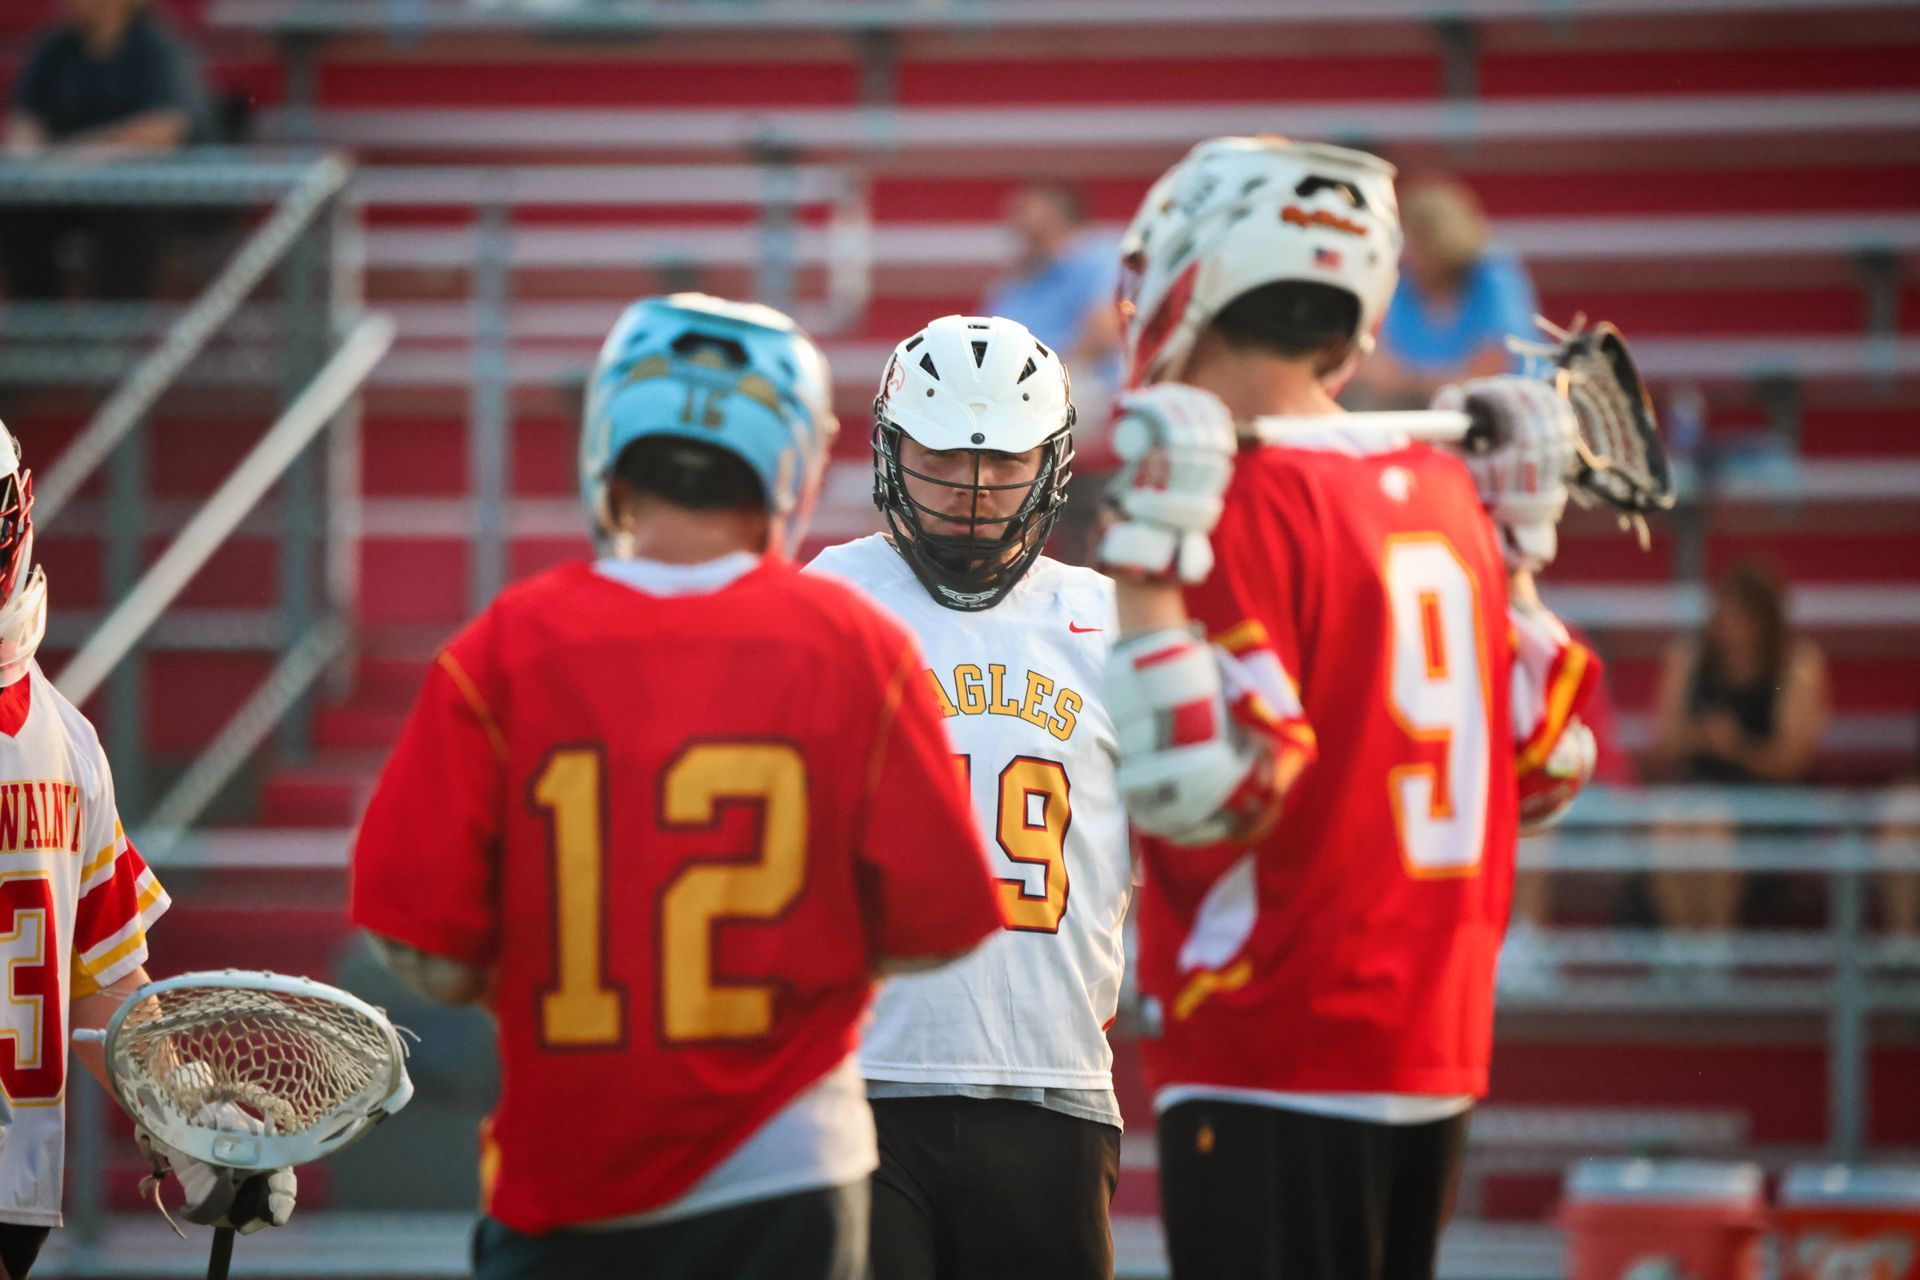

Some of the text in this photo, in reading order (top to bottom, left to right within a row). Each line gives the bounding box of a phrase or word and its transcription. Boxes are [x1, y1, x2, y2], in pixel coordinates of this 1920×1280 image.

[950, 753, 1073, 935] 9
[1384, 531, 1492, 880] 9
[524, 736, 808, 1052] 12
